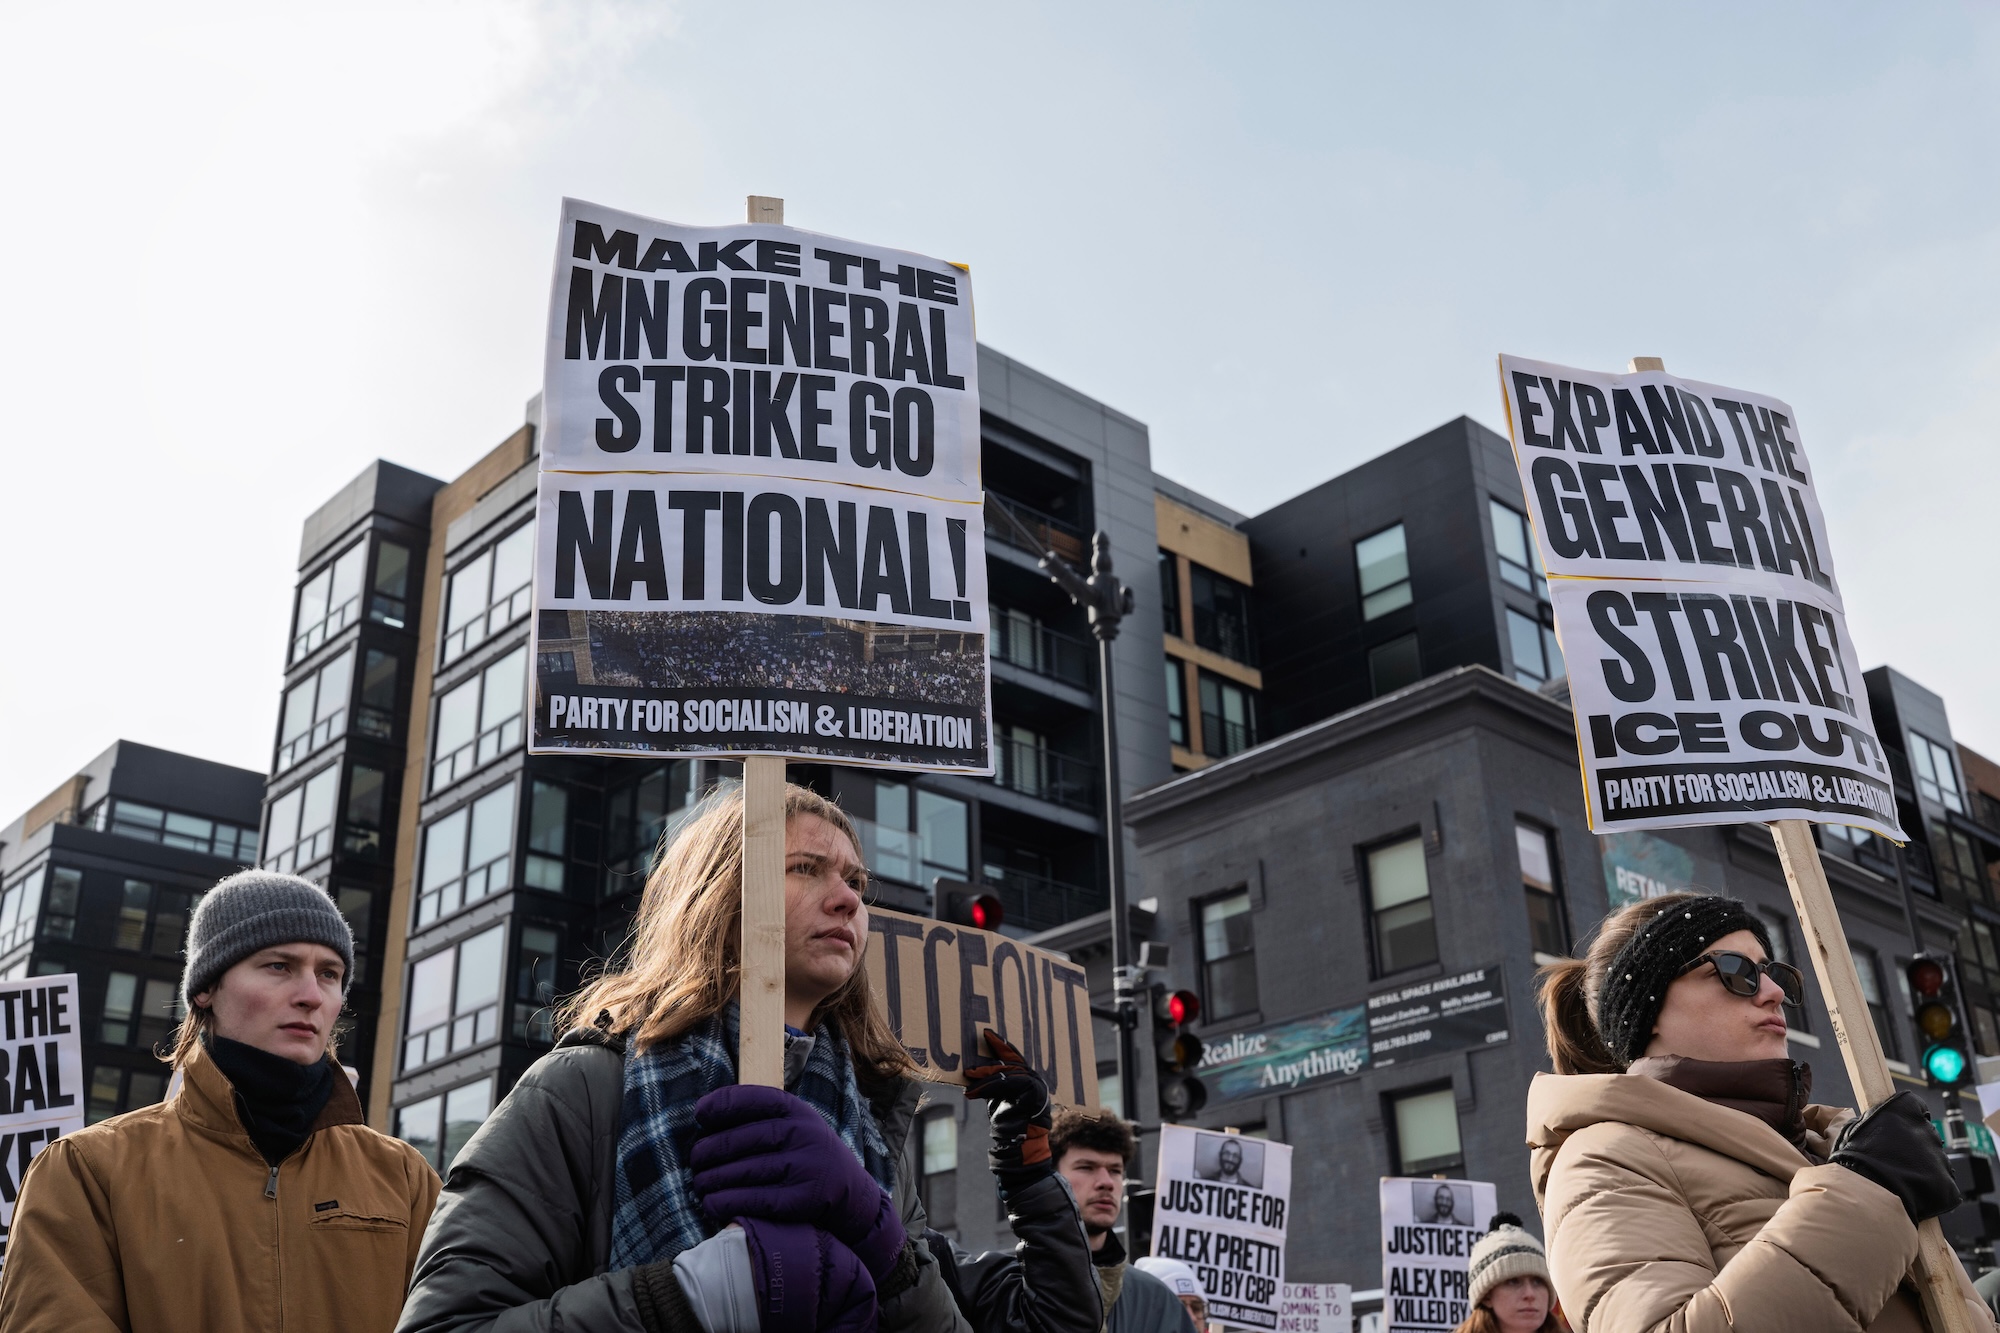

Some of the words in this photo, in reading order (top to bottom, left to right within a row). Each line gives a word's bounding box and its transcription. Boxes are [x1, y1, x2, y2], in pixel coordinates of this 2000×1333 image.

[572, 219, 801, 277] MAKE
[814, 247, 959, 305] THE
[565, 266, 670, 361] MN
[682, 277, 965, 391] GENERAL
[595, 365, 837, 464] STRIKE
[849, 380, 934, 478] GO
[1511, 370, 1725, 459] EXPAND
[1711, 397, 1808, 486] THE
[1531, 456, 1834, 595] GENERAL
[554, 489, 972, 622] NATIONAL!
[1586, 590, 1859, 720] STRIKE!
[549, 694, 629, 730] PARTY
[632, 698, 680, 732] FOR
[683, 698, 810, 735] SOCIALISM
[814, 704, 844, 738] &
[849, 707, 973, 750] LIBERATION
[1589, 712, 1730, 759] ICE
[1739, 710, 1886, 774] OUT!
[1604, 776, 1672, 810] PARTY
[1673, 773, 1718, 804] FOR
[1716, 770, 1811, 803] SOCIALISM
[1812, 774, 1836, 803] &
[1831, 776, 1895, 821] LIBERATION
[1368, 993, 1401, 1009] RETAIL
[1401, 983, 1432, 1001] SPACE
[1432, 970, 1485, 993] AVAILABLE
[1197, 1033, 1267, 1068] Realize
[1260, 1047, 1363, 1088] Anything.
[1161, 1179, 1249, 1222] JUSTICE
[1251, 1192, 1285, 1230] FOR
[1157, 1225, 1212, 1264] ALEX
[1214, 1233, 1280, 1278] PRETTI
[1388, 1226, 1464, 1257] JUSTICE
[1221, 1270, 1244, 1299] BY
[1245, 1275, 1275, 1305] CBP
[1326, 1286, 1336, 1299] IS
[1390, 1267, 1437, 1298] ALEX
[1281, 1302, 1320, 1315] OMING
[1324, 1303, 1341, 1316] TO
[1281, 1318, 1300, 1332] AVE
[1304, 1318, 1319, 1332] US
[1394, 1298, 1447, 1324] KILLED
[1450, 1301, 1468, 1324] BY
